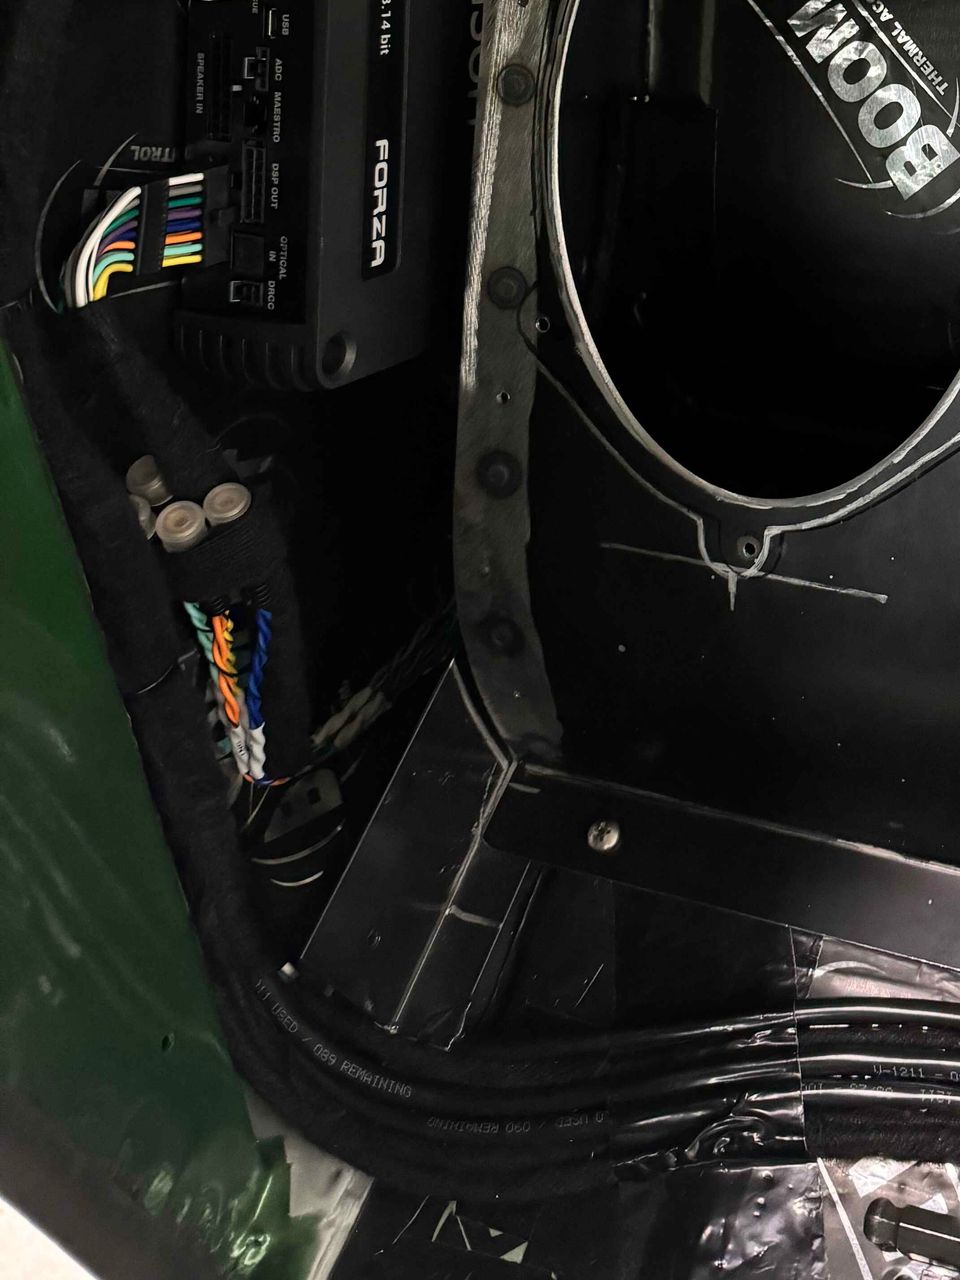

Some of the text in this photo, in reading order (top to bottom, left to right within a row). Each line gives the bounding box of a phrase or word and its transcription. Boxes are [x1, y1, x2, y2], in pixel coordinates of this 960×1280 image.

[282, 14, 290, 36] USB
[380, 34, 391, 56] bit
[195, 52, 205, 114] SPEAKER IN
[275, 57, 283, 81] ADC
[887, 23, 950, 97] THERMAL
[273, 91, 282, 143] MAESTRO
[270, 163, 280, 210] DSP OUT
[370, 138, 389, 269] FORZA
[269, 235, 288, 280] OPTICAL IN
[313, 1043, 338, 1066] 089
[340, 1060, 412, 1098] REMAINING
